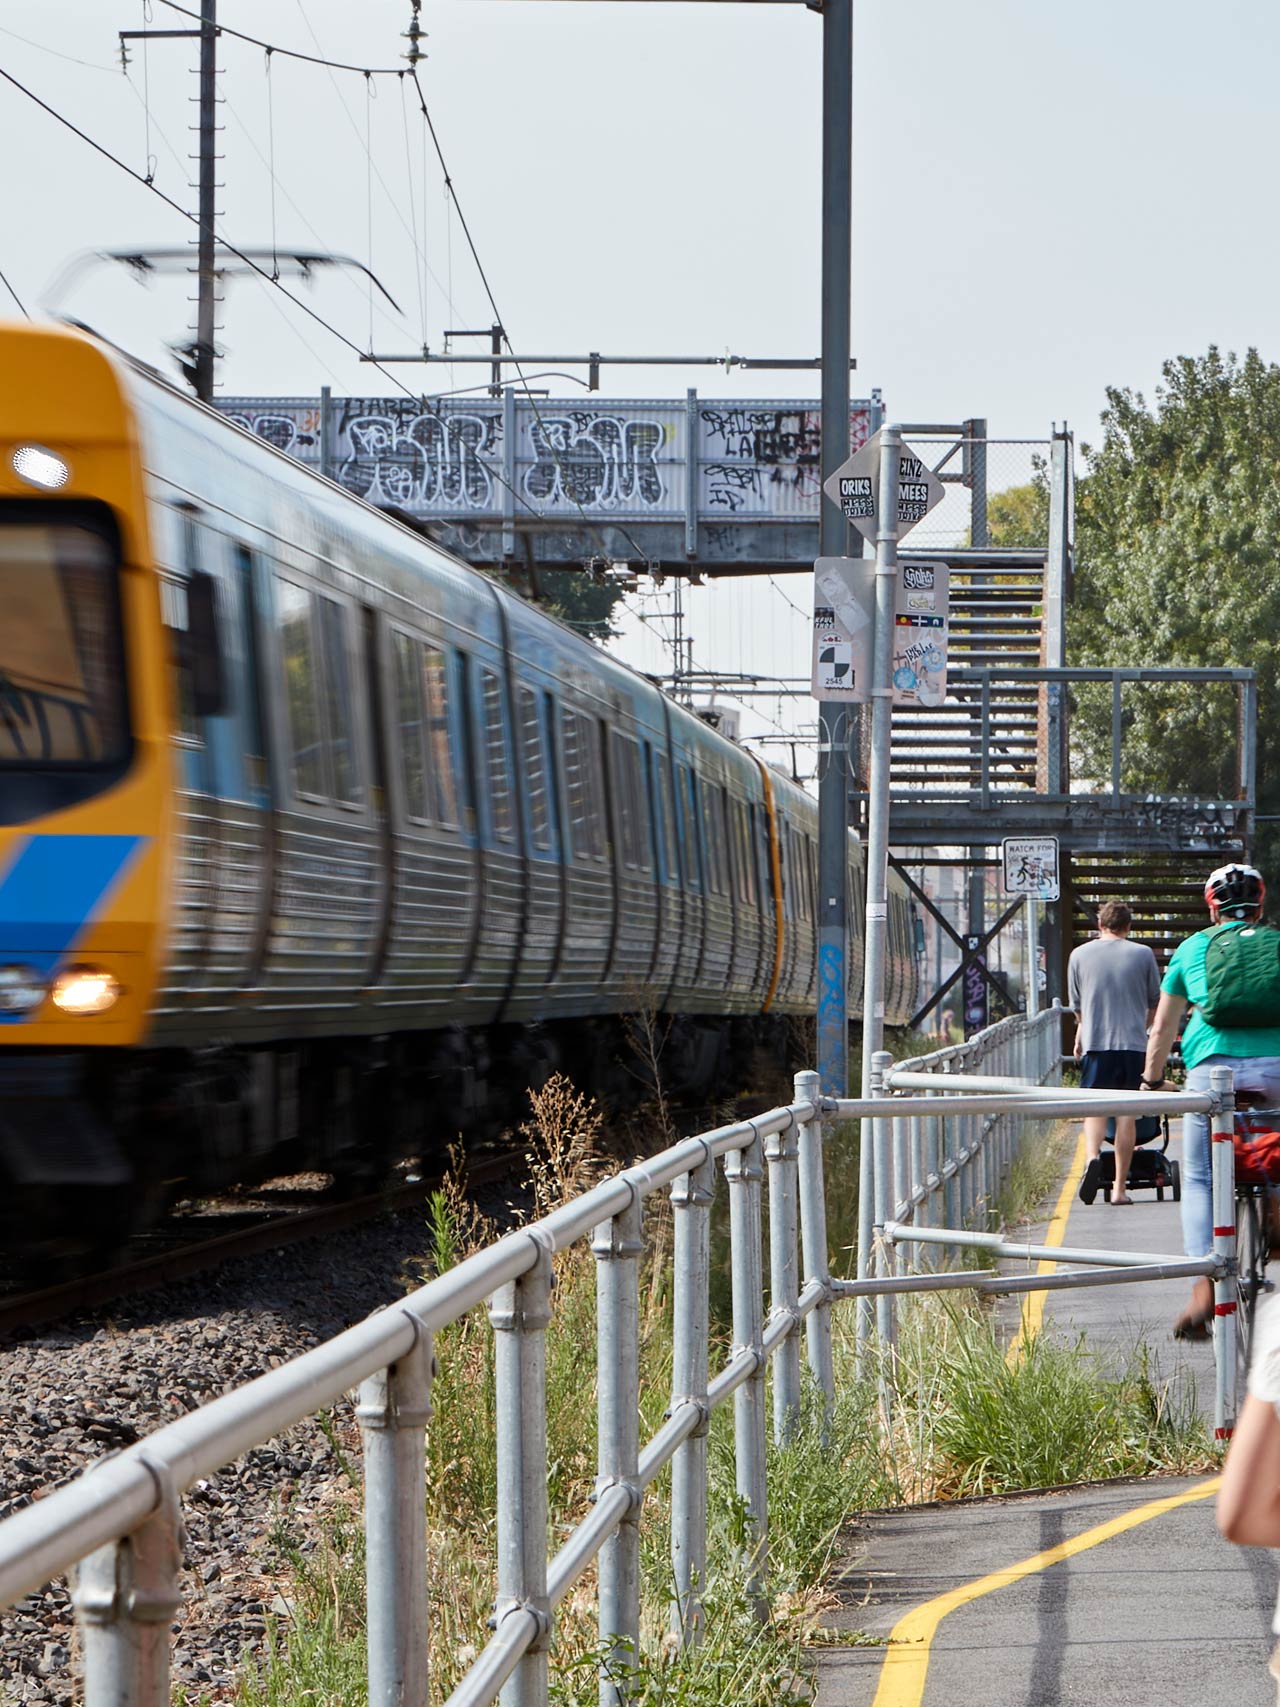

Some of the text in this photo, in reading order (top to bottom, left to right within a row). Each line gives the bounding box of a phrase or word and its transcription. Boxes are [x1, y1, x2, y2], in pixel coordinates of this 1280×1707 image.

[841, 479, 871, 495] ORIKS
[899, 484, 927, 501] MEES
[826, 677, 843, 685] 2545
